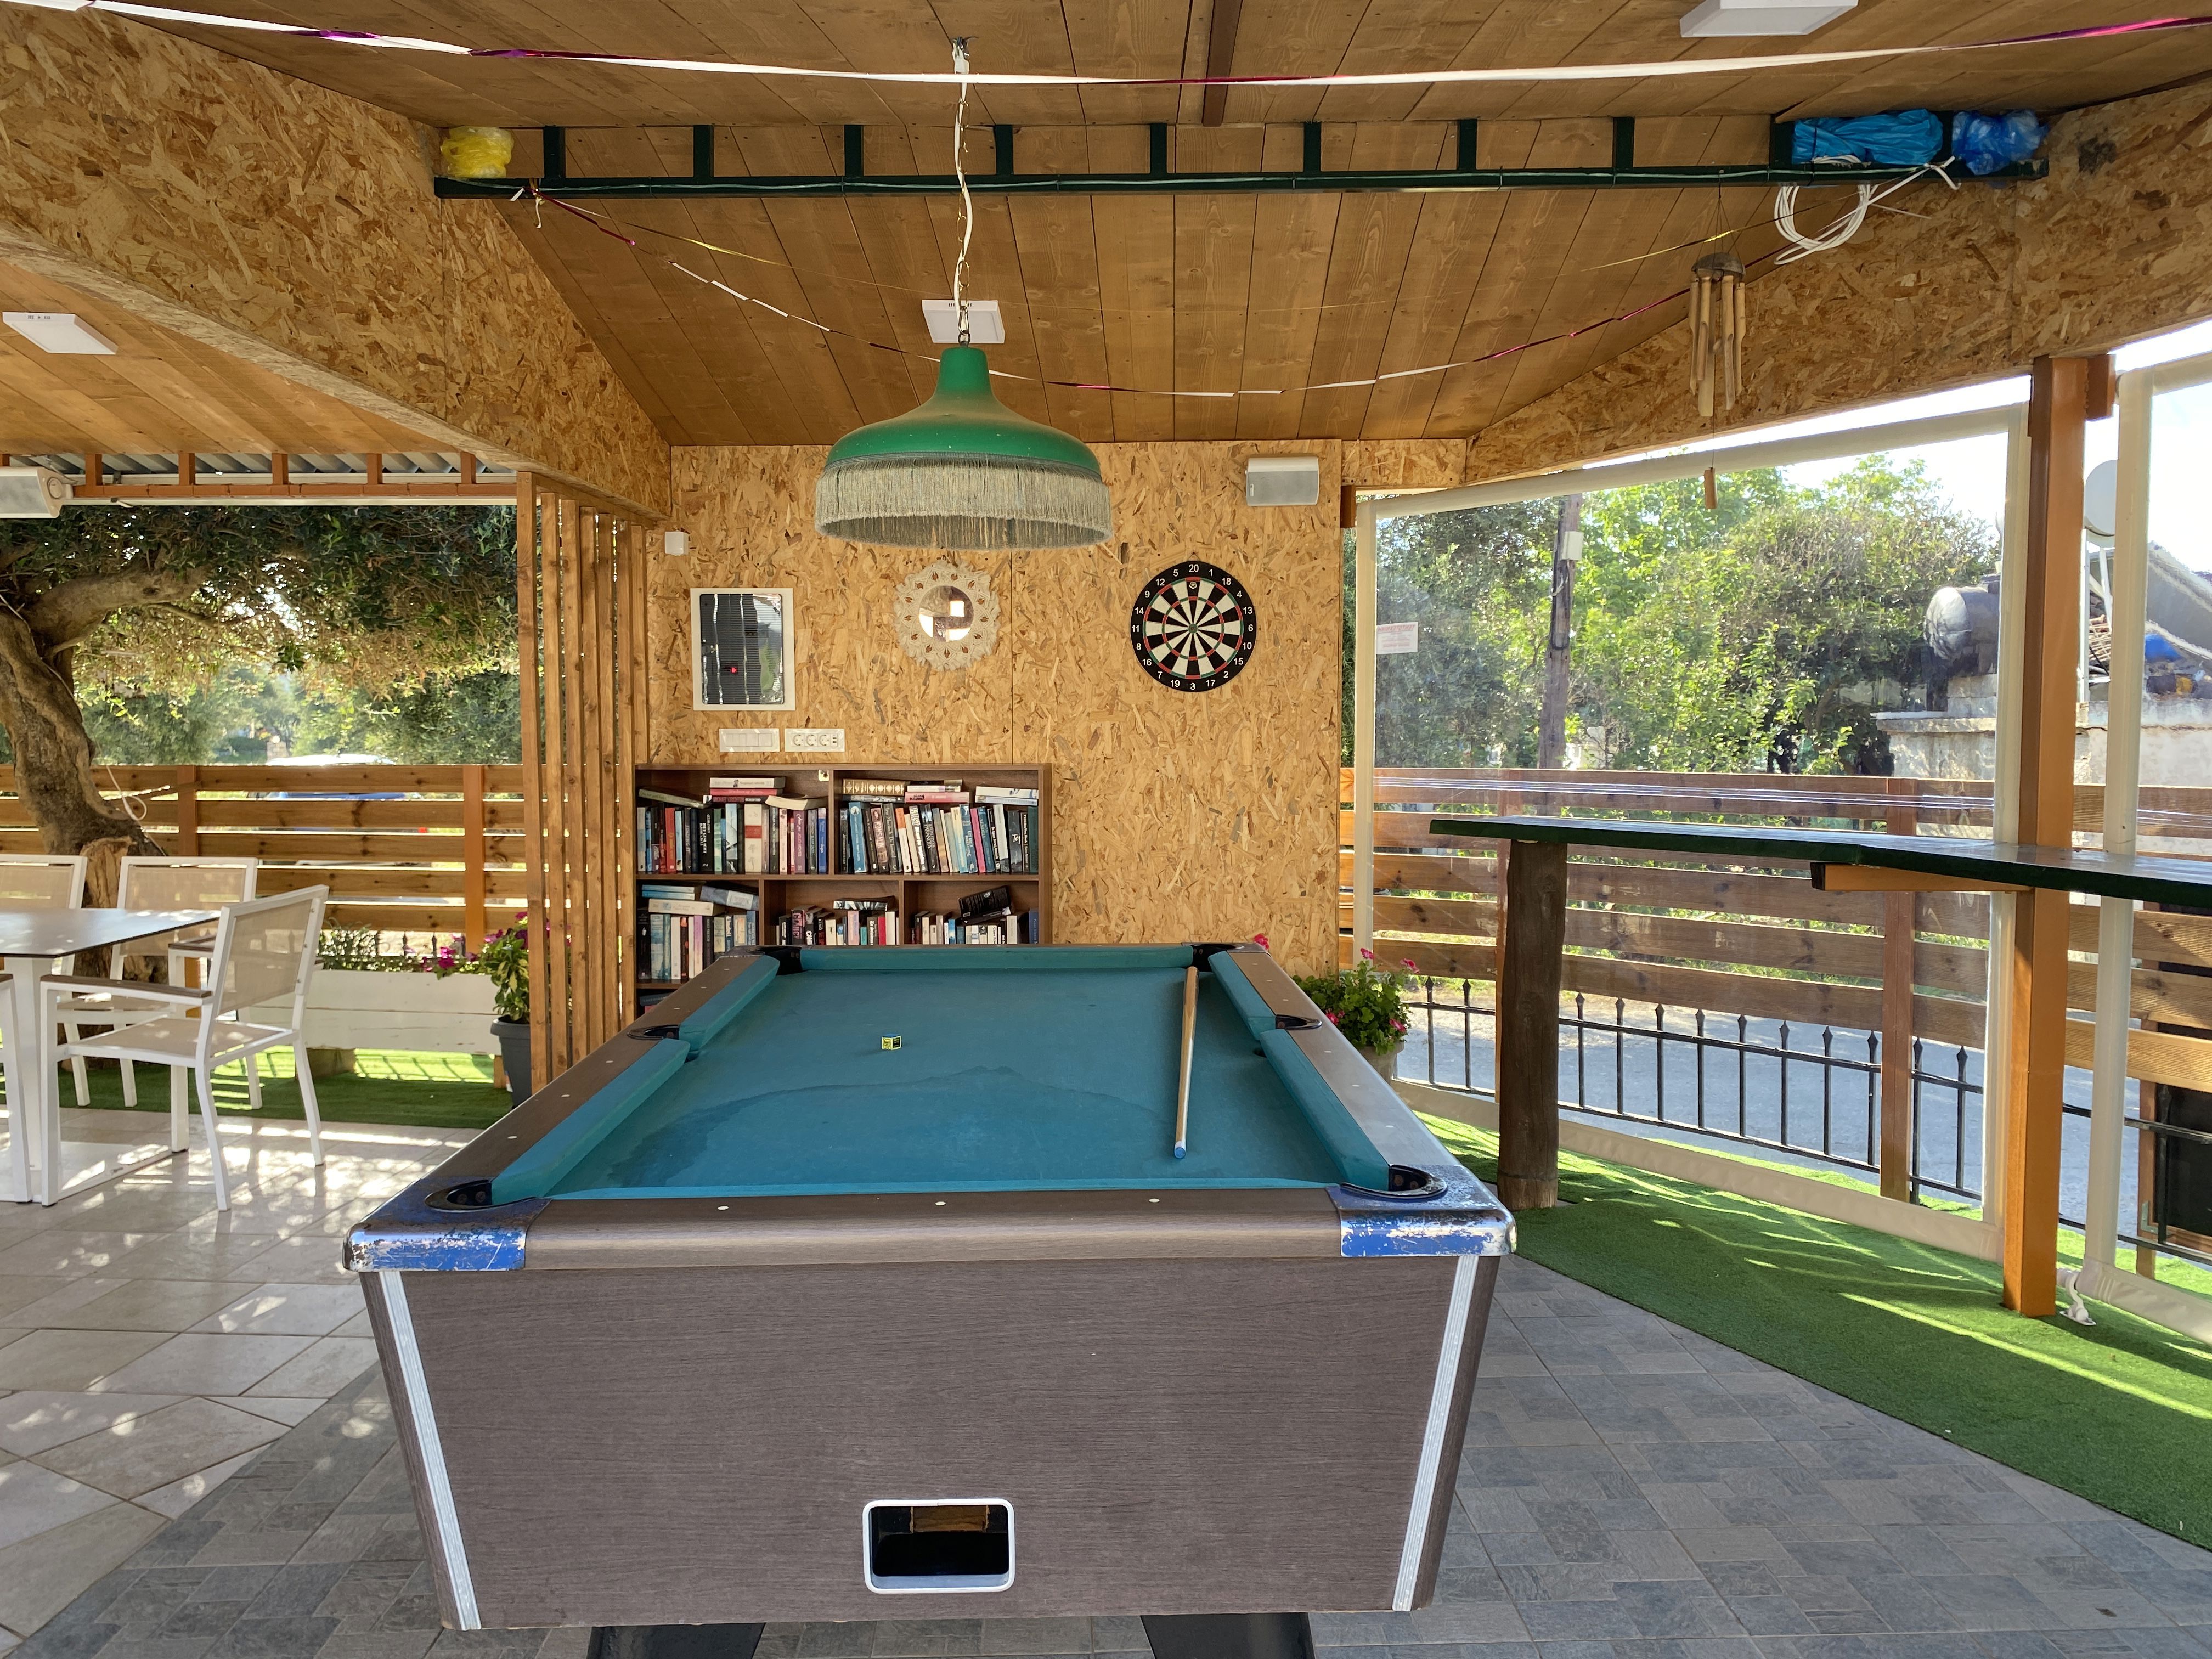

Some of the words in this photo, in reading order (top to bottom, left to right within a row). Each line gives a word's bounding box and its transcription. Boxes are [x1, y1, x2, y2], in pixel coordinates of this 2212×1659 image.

[1189, 564, 1199, 572] 20
[874, 821, 884, 849] KONSALIK
[923, 824, 932, 849] PARANOIA
